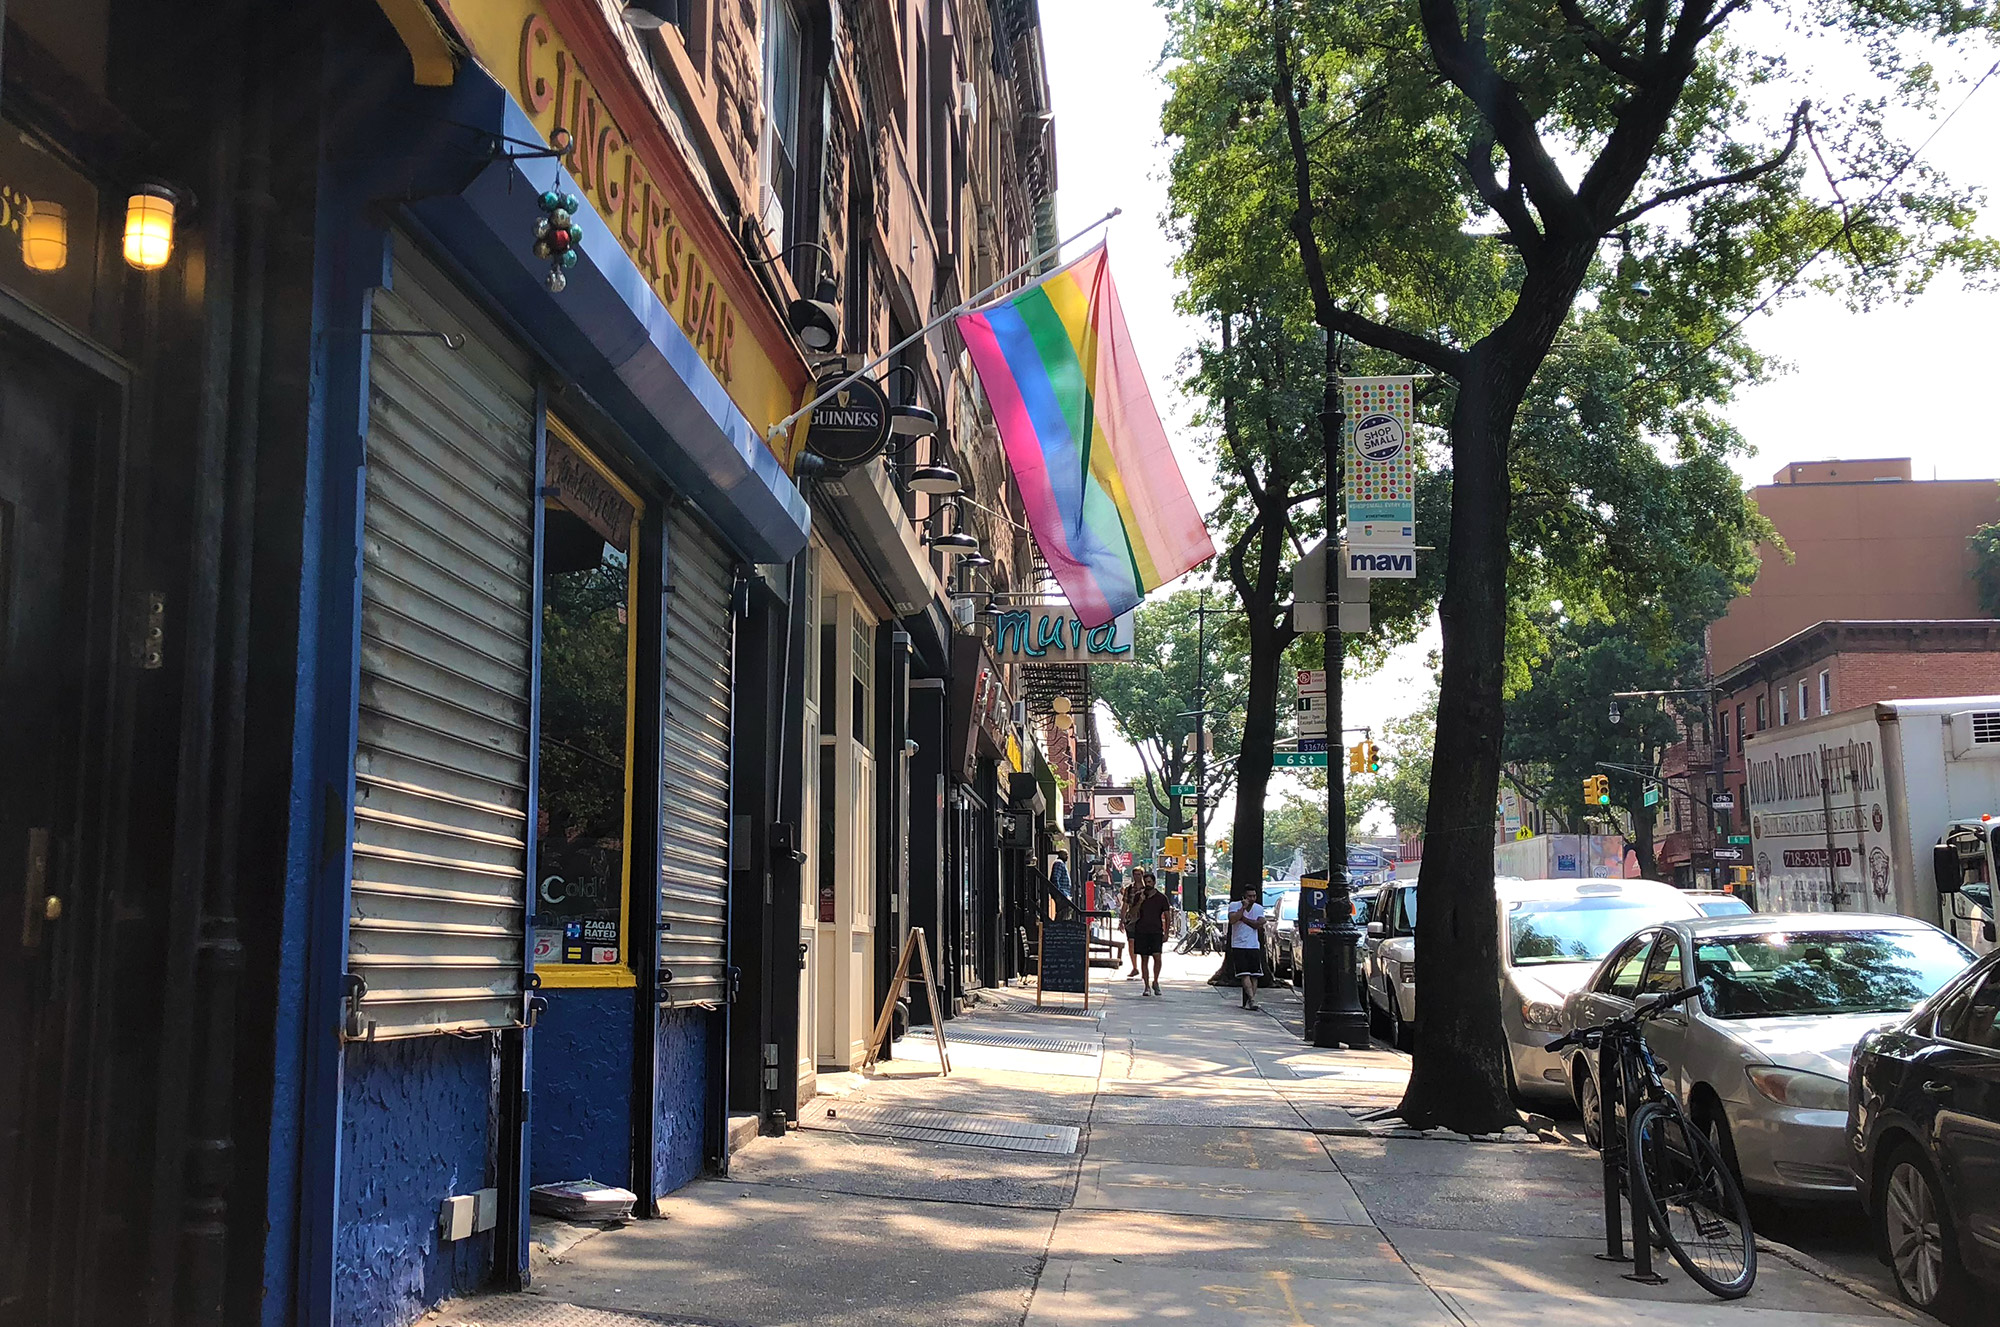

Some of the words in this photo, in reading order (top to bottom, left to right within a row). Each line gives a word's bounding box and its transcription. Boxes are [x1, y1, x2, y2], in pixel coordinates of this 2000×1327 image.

[519, 13, 684, 306] GINGER'S
[683, 253, 738, 383] BAR
[810, 409, 879, 427] GUINNESS
[1364, 426, 1392, 441] SHOP
[1364, 434, 1398, 450] SMALL
[1351, 554, 1412, 571] mavi
[1302, 699, 1307, 710] 1
[1286, 755, 1294, 764] 6
[1299, 755, 1314, 764] St
[1747, 758, 1776, 806] ROMEO
[1775, 751, 1821, 801] BROTHERS
[1177, 786, 1183, 794] 6
[541, 875, 598, 904] Cold
[1314, 891, 1324, 906] P
[584, 929, 617, 938] RATED
